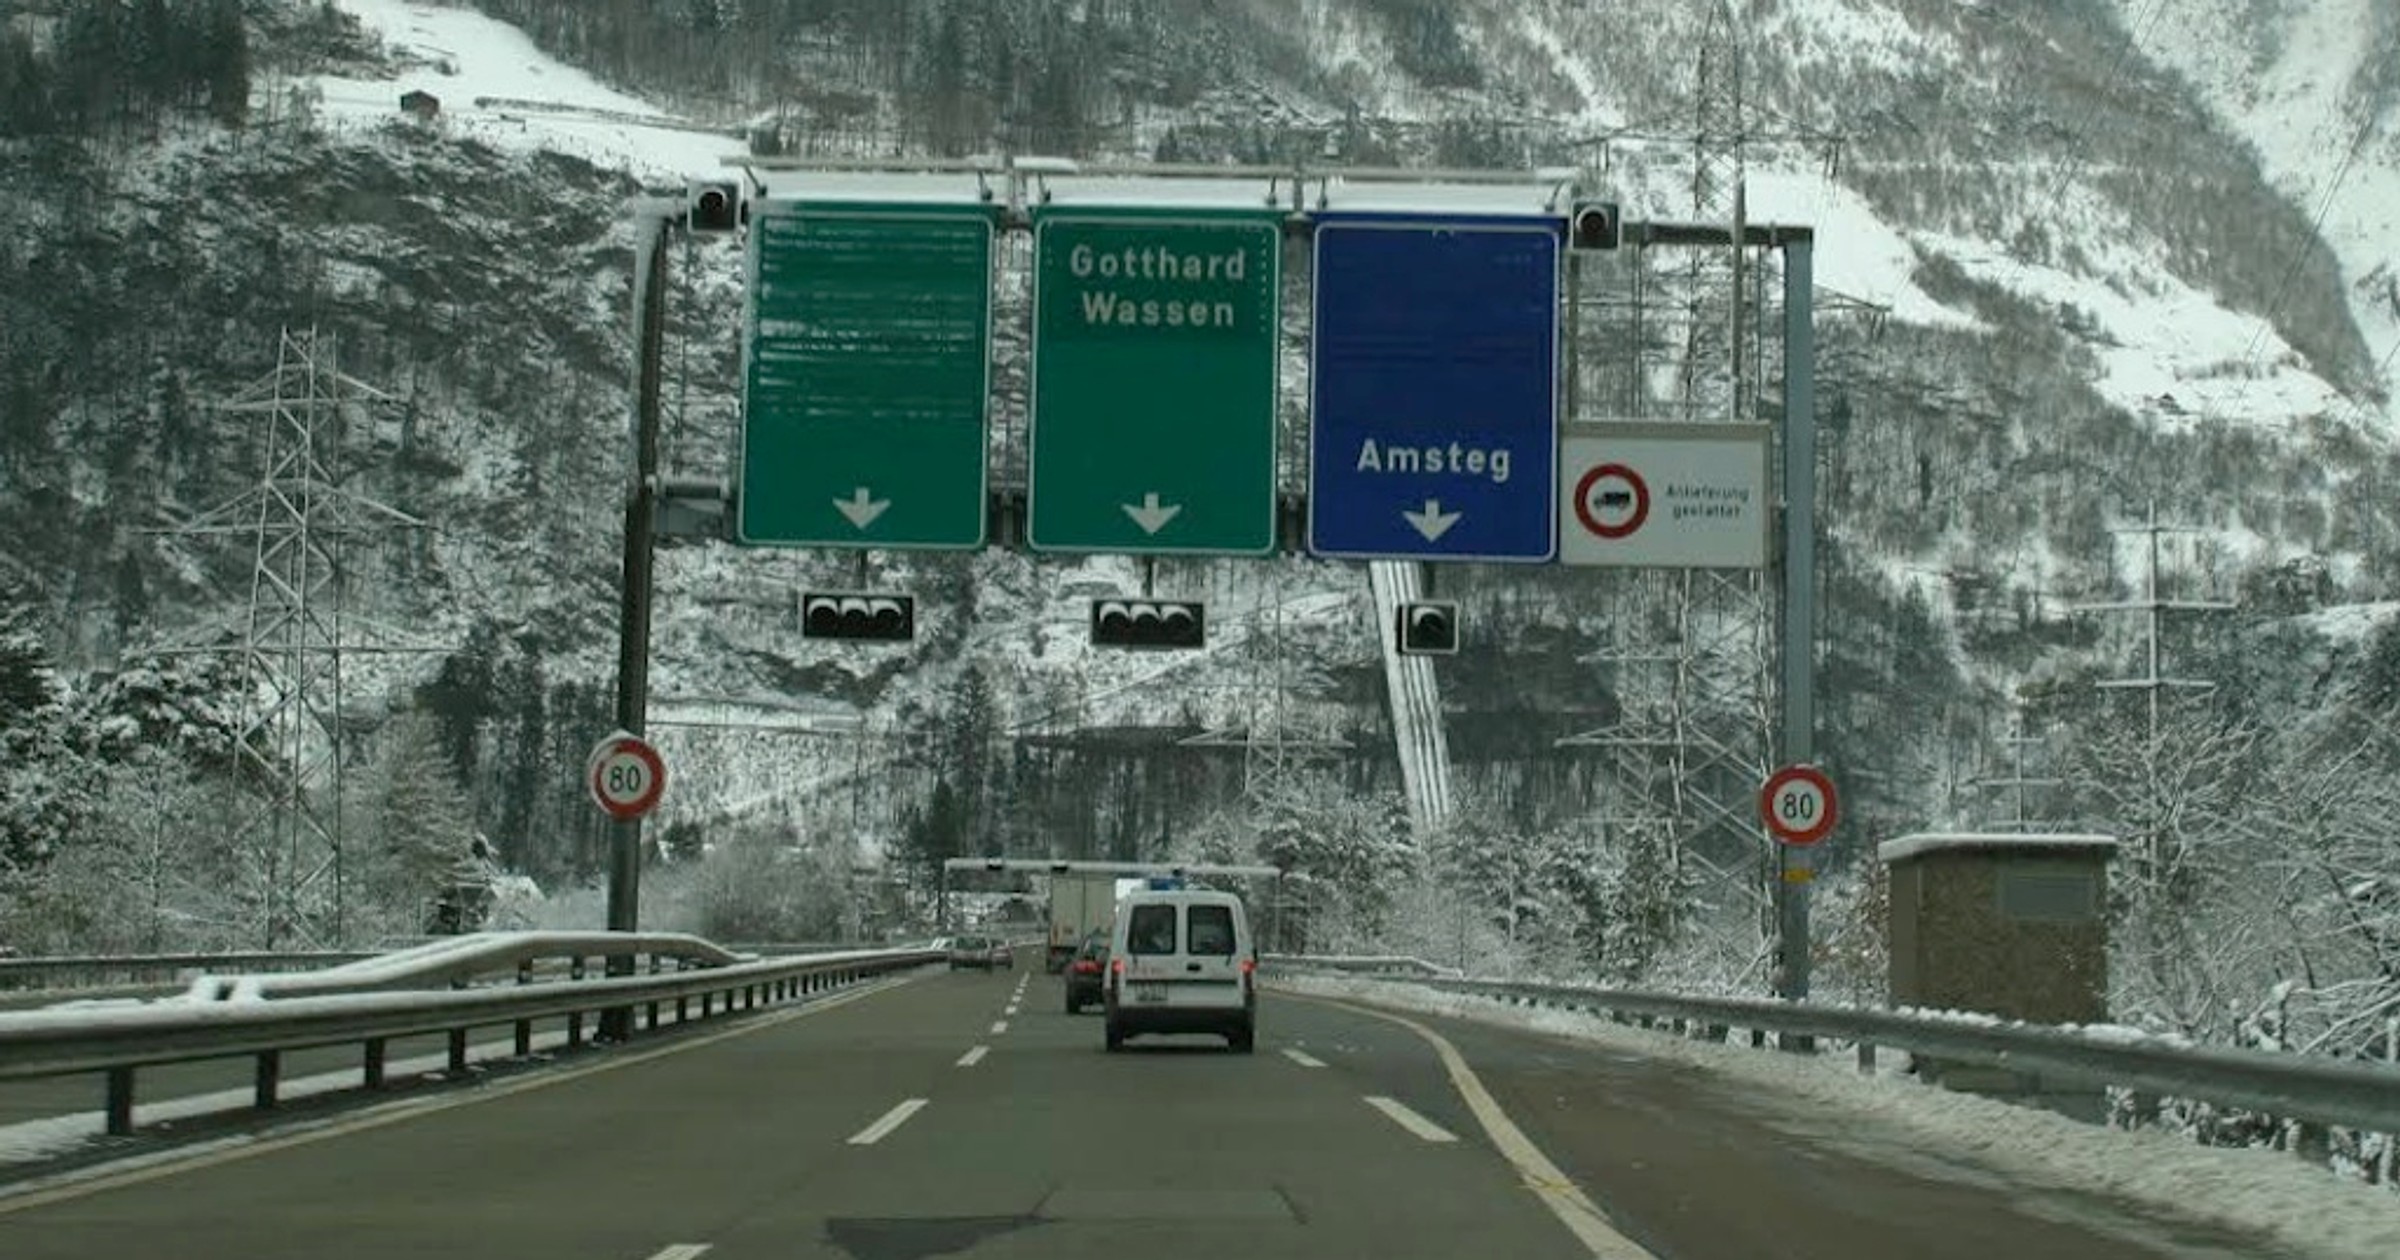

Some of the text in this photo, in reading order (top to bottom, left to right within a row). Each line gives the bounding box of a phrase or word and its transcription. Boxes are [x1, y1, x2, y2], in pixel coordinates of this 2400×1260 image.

[1070, 245, 1246, 280] Gotthard
[1082, 291, 1235, 326] Wassen
[1357, 437, 1511, 483] Amsteg
[610, 766, 641, 793] 80
[1783, 792, 1813, 819] 80
